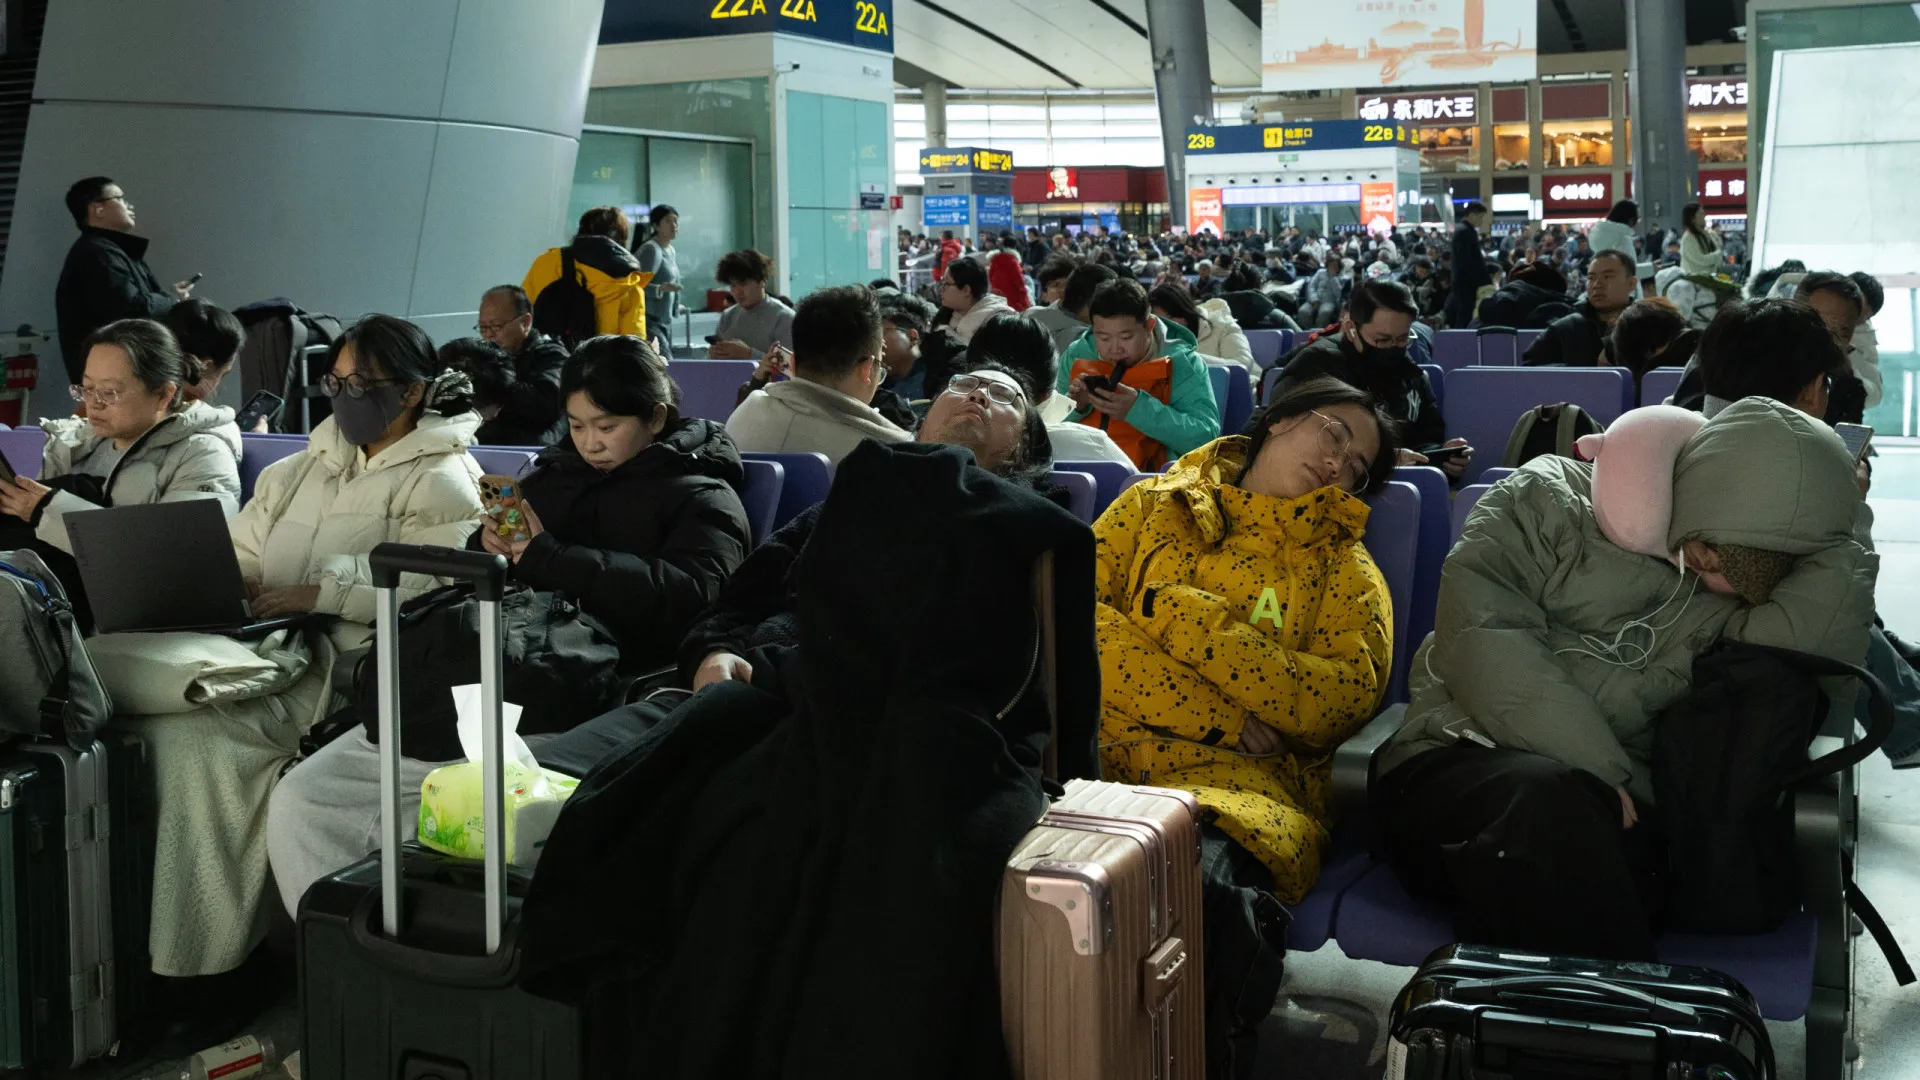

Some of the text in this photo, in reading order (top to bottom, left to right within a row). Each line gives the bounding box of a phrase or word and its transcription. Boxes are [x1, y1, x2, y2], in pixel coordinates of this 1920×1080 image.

[855, 1, 889, 36] 22A
[1393, 96, 1475, 120] 永和大王
[1187, 133, 1215, 149] 23B
[1364, 125, 1394, 141] 22B
[1250, 588, 1283, 627] A
